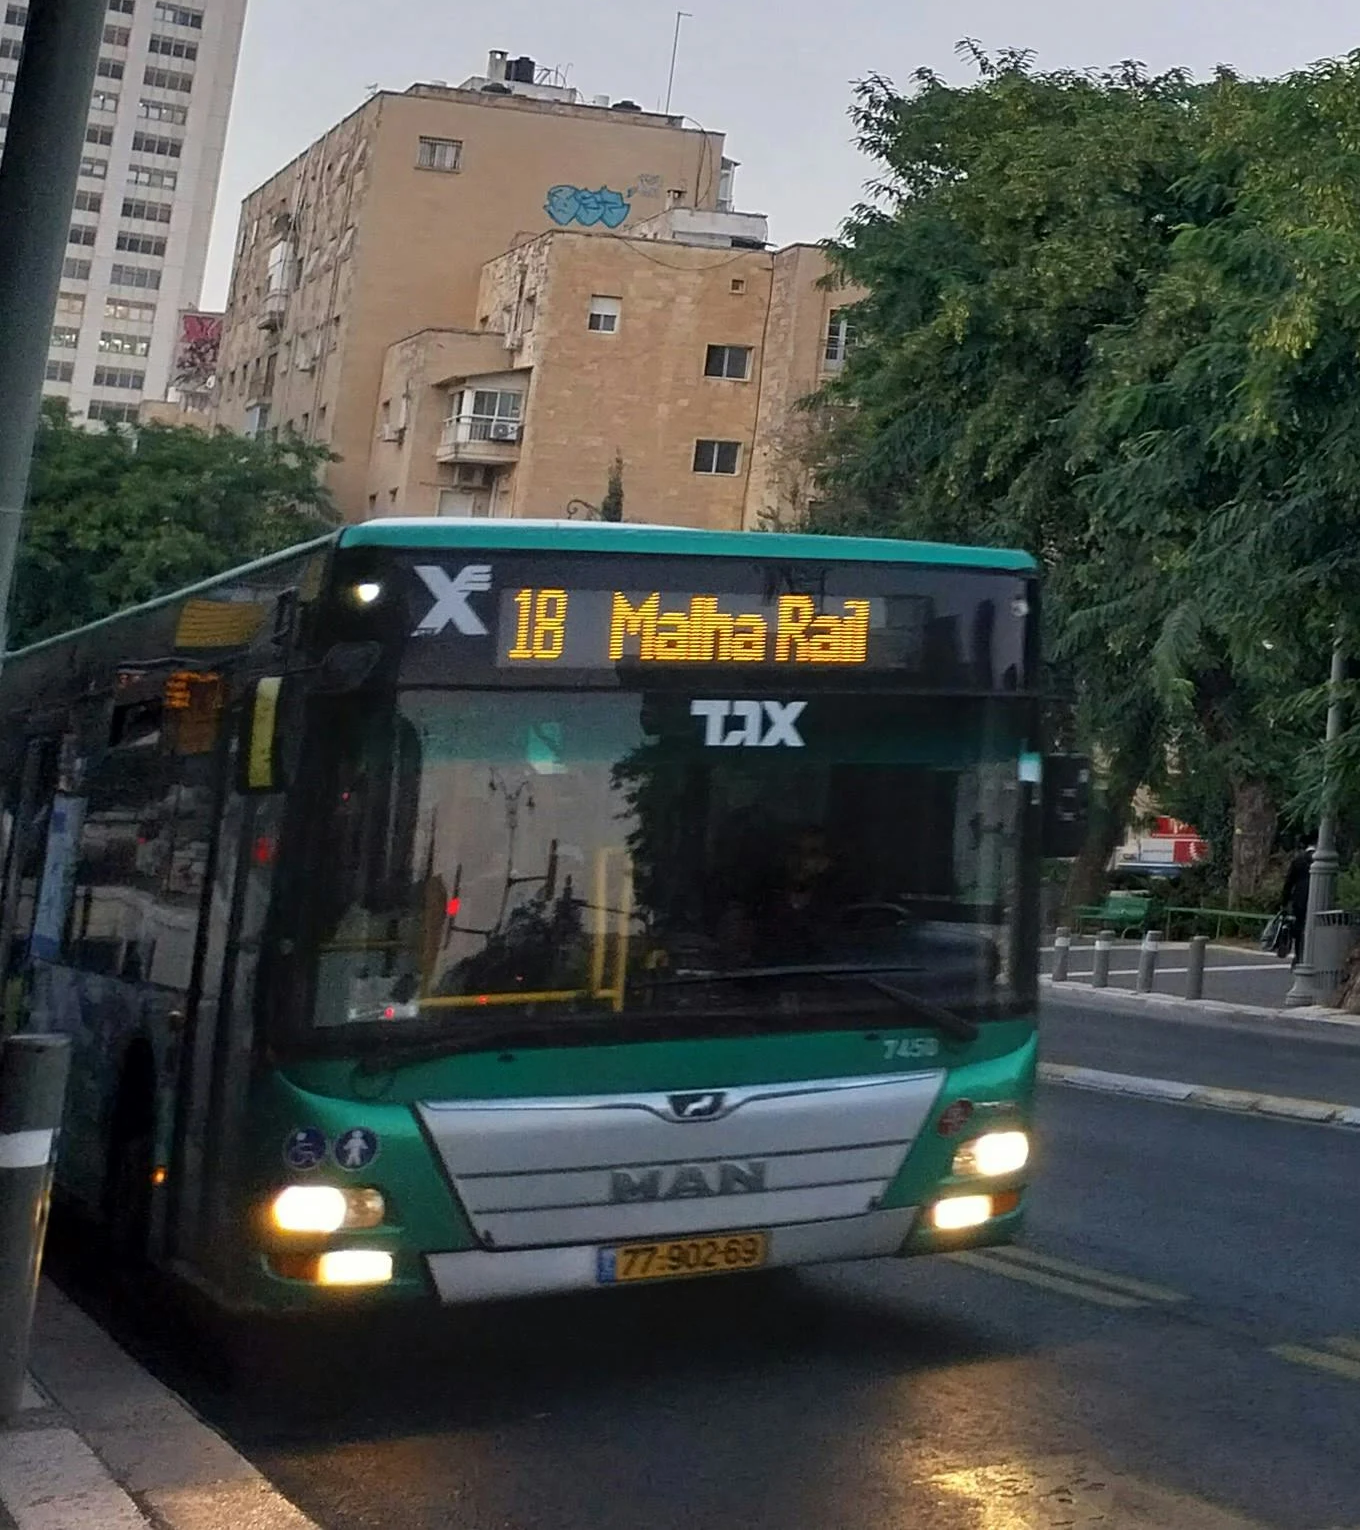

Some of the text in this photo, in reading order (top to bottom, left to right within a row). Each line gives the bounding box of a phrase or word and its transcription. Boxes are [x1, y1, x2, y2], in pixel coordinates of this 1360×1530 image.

[507, 587, 871, 663] 18 Malha Rail
[690, 699, 808, 747] אגד
[611, 1160, 766, 1202] MAN
